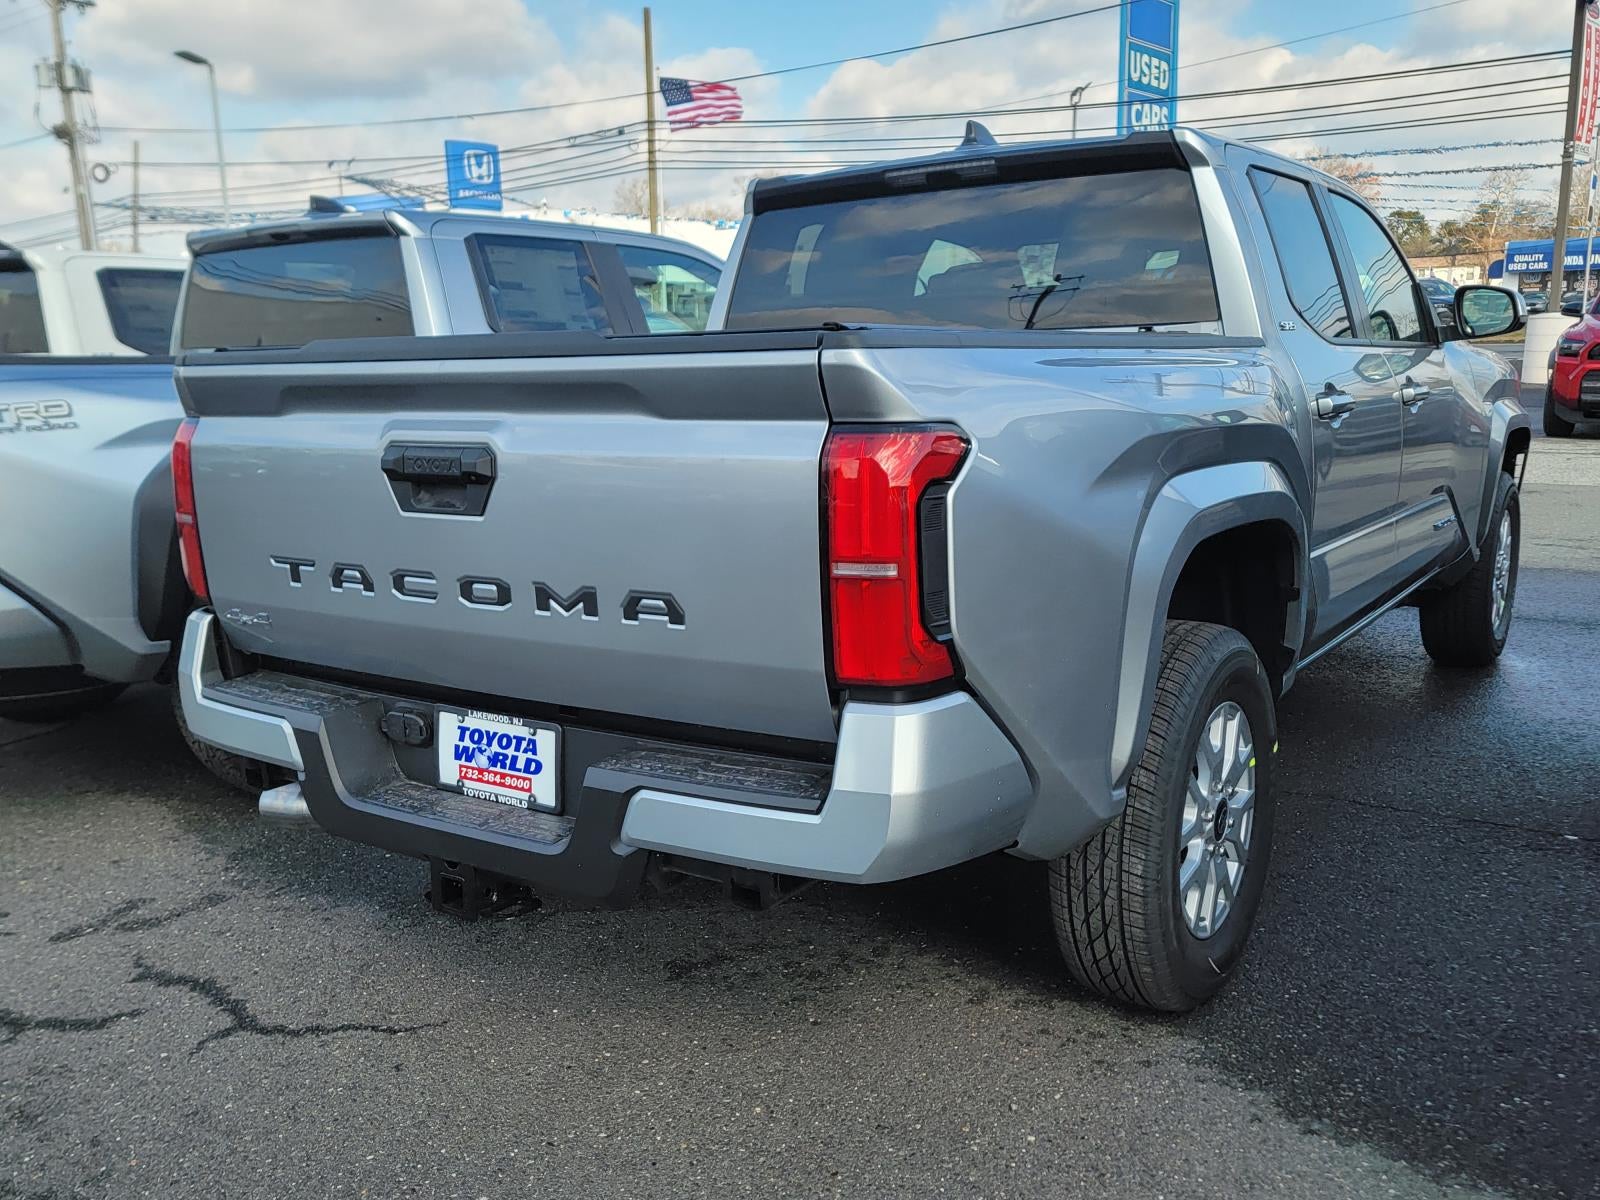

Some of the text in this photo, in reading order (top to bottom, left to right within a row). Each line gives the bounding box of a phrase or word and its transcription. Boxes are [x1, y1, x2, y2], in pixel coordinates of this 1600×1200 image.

[1130, 50, 1169, 90] USED
[1577, 28, 1591, 137] TOYOTA
[1131, 101, 1168, 131] CARS
[1508, 262, 1548, 271] USED CARS
[1514, 254, 1544, 262] QUALITY
[1564, 256, 1584, 265] ONDA
[408, 458, 458, 473] TOYOTA
[269, 555, 687, 631] TACOMA
[513, 717, 523, 726] NJ
[457, 725, 537, 756] TOYOTA
[453, 743, 543, 776] WORLD
[460, 767, 530, 789] 732-364-9000
[463, 788, 528, 809] TOYOTA WORLD
